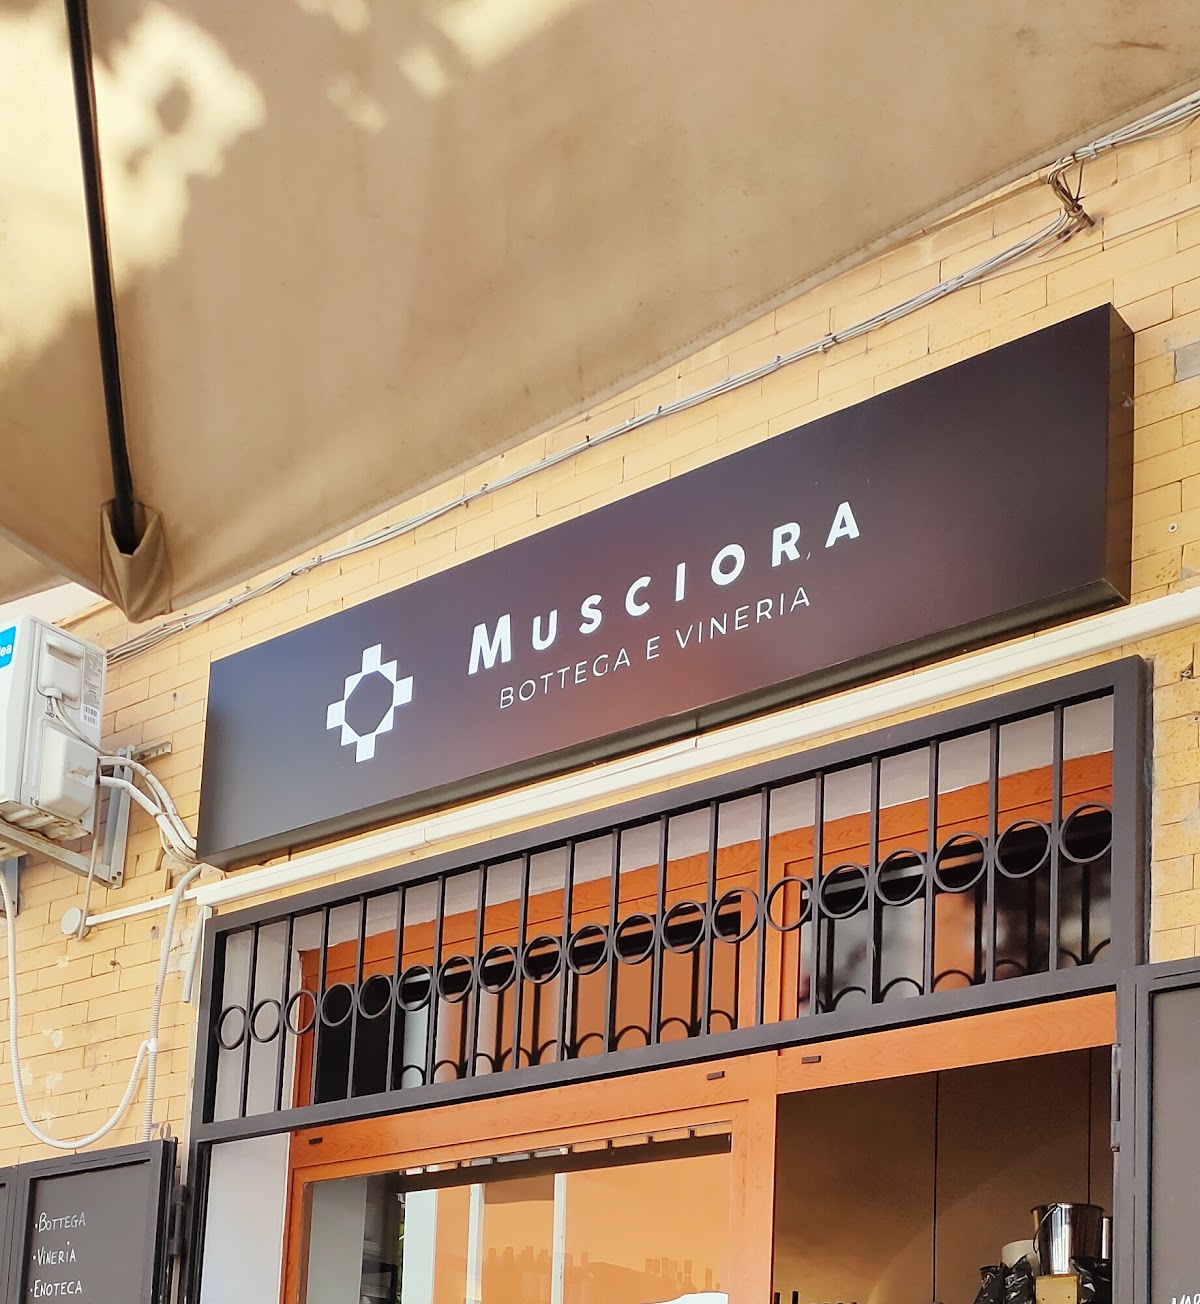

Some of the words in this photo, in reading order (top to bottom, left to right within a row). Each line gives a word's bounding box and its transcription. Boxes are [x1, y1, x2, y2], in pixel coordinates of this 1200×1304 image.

[467, 501, 861, 676] MUSCIORA
[0, 643, 12, 657] ea
[499, 647, 631, 710] BOTTEGA
[646, 635, 660, 660] E
[675, 586, 811, 650] VINERIA
[38, 1211, 86, 1233] BOTTEGA
[33, 1279, 83, 1298] ENOTECA
